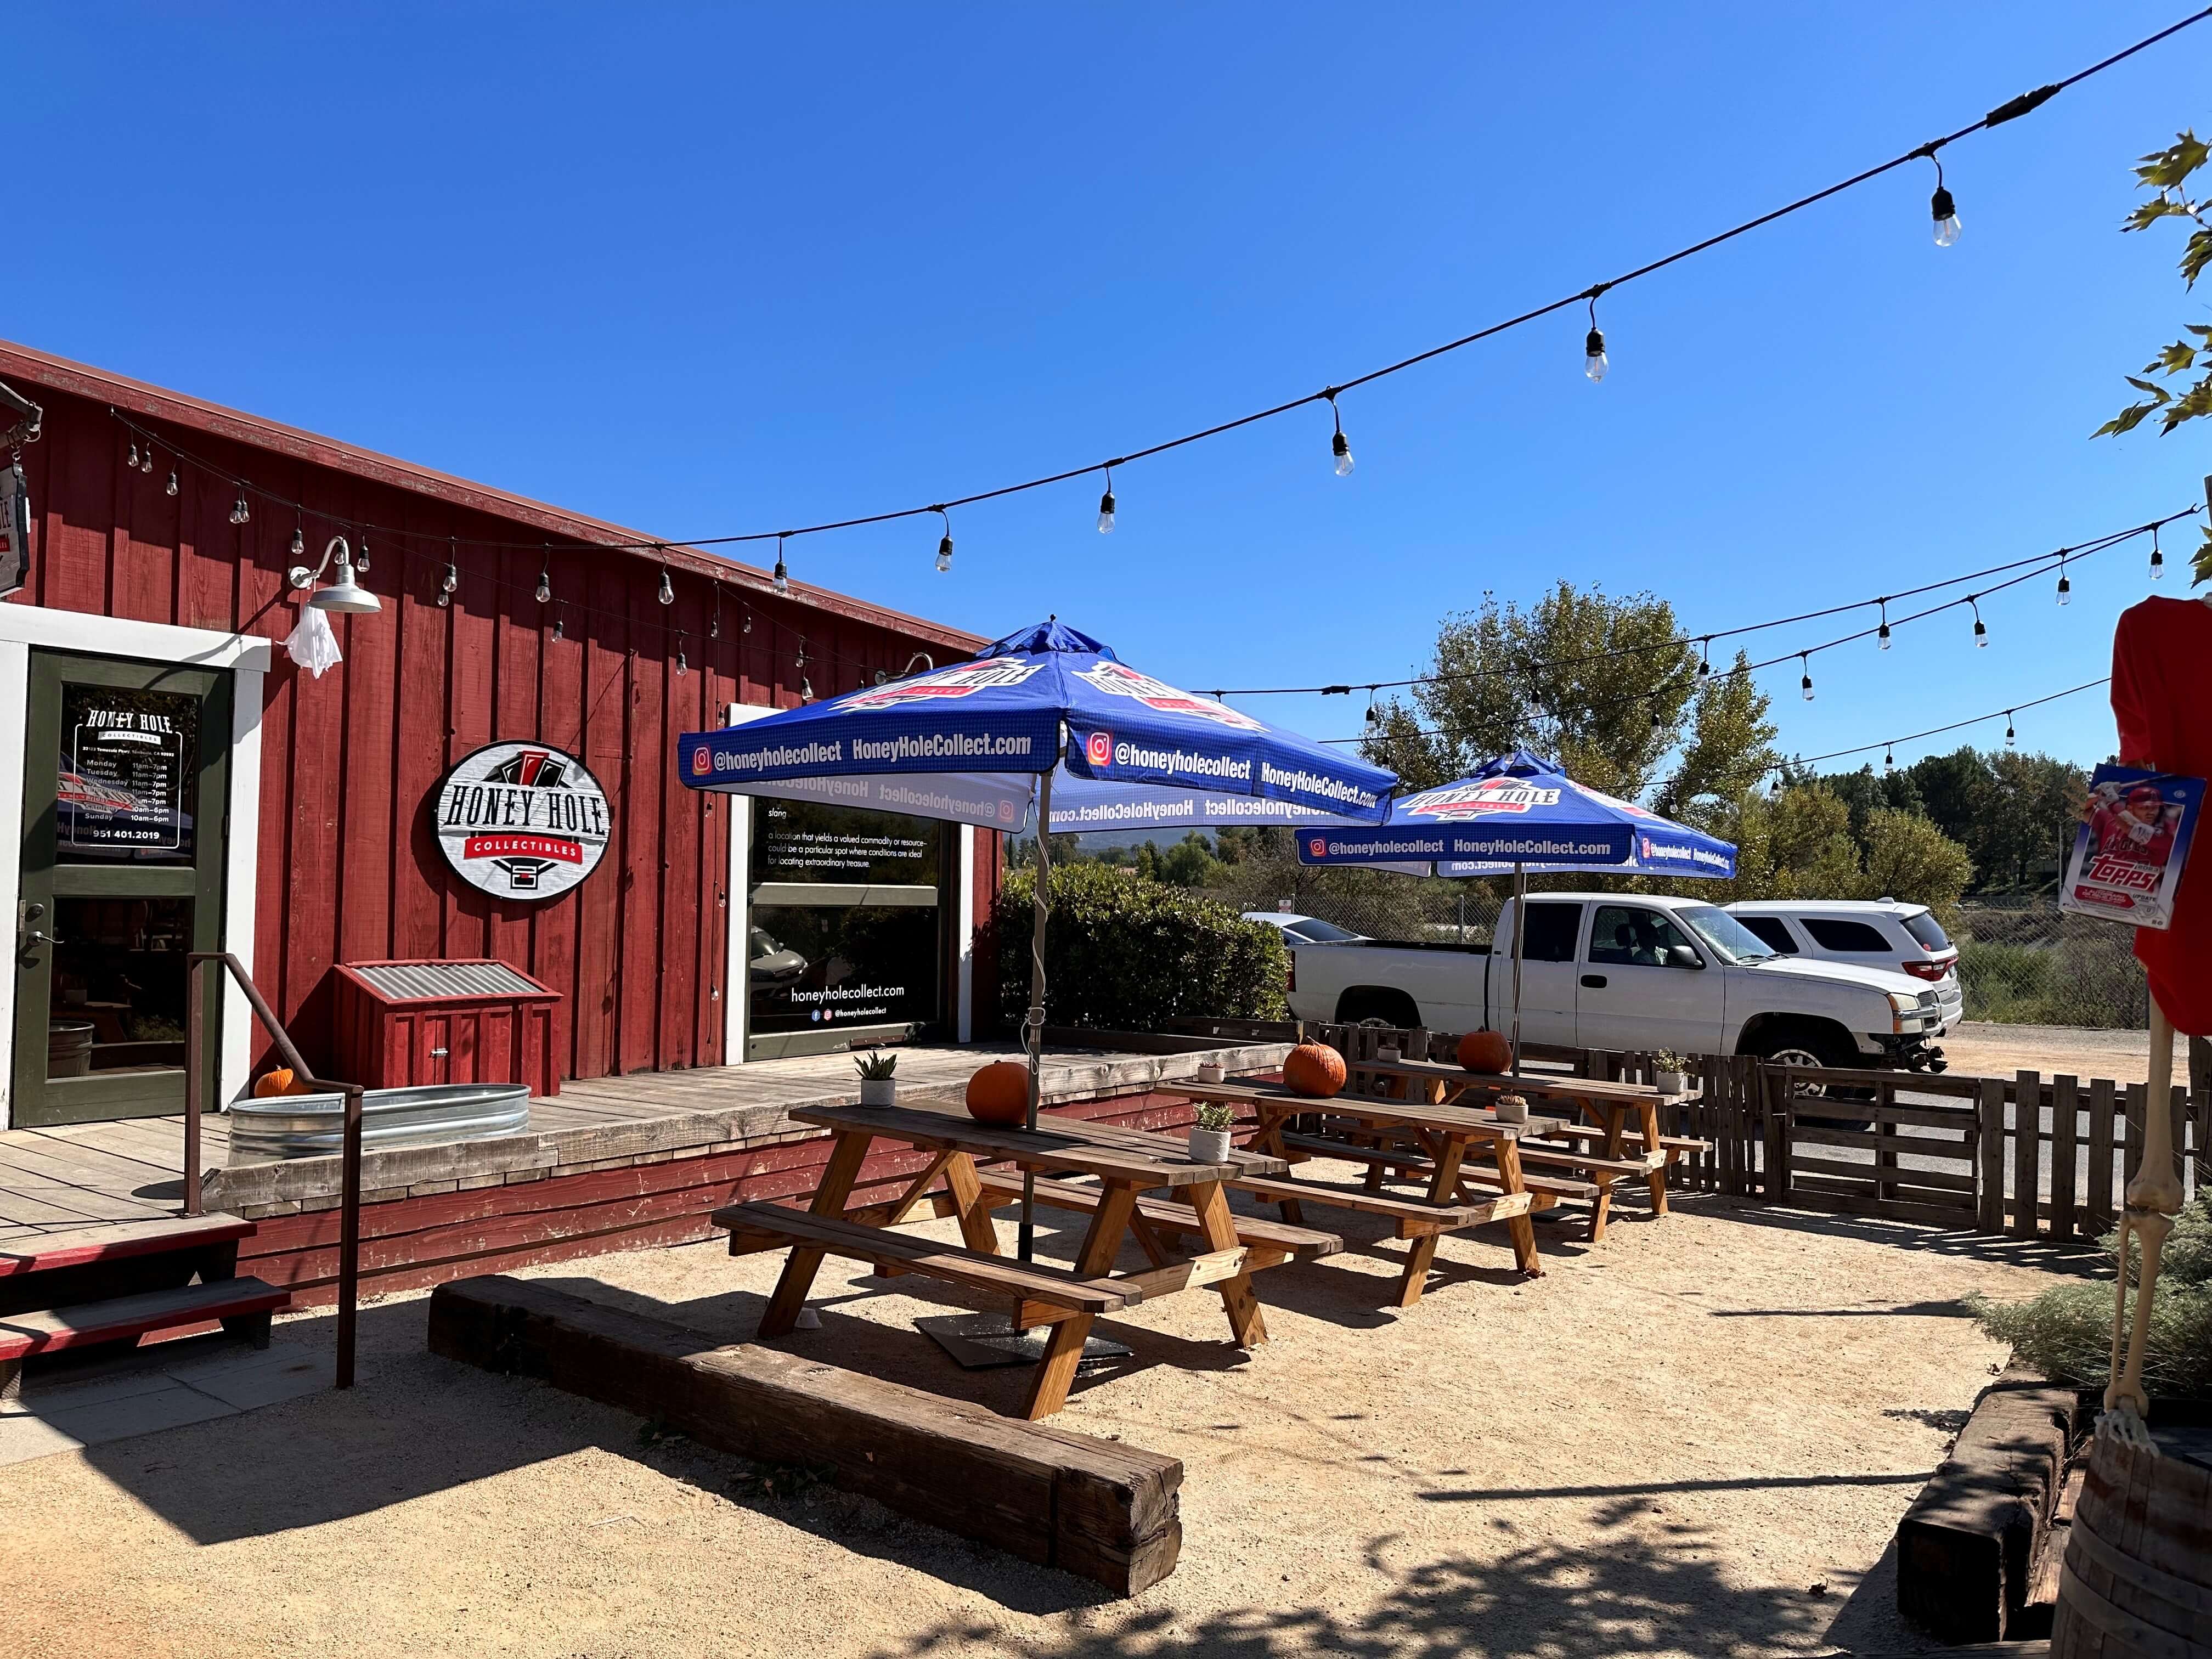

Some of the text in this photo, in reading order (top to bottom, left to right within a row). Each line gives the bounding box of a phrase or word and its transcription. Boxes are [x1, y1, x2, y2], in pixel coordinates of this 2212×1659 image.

[955, 667, 1035, 685] HOLE
[86, 710, 173, 734] HONEY HOLE
[714, 733, 1031, 772] @honeyholecollect HoneyHoleCollect.com
[87, 759, 117, 768] Monday
[87, 768, 117, 777] Tuesday
[1115, 742, 1378, 809] @honeyholecollect HoneyHoleCollect.com
[86, 777, 128, 787] Wednesday
[1407, 790, 1556, 806] HONEY HOLE
[444, 785, 606, 836] HONEY HOLE
[768, 807, 787, 819] slang
[775, 830, 800, 840] location
[802, 831, 814, 841] that
[815, 832, 832, 843] yields
[839, 833, 860, 843] valued
[861, 836, 893, 847] commodity
[473, 840, 577, 857] COLLECTIBLES
[768, 842, 787, 853] could
[788, 843, 797, 853] be
[805, 844, 833, 856] particular
[834, 847, 848, 857] spot
[849, 845, 867, 856] where
[868, 847, 897, 857] conditions
[908, 849, 922, 858] ideal
[1329, 839, 1611, 856] @honeyholecollect HoneyHoleCollect.com
[1650, 843, 1691, 860] @honeyholecollect
[768, 854, 777, 865] for
[778, 855, 804, 868] locating
[805, 857, 845, 869] extraordinary
[2132, 893, 2157, 902] UPDATE
[792, 983, 904, 1005] honeyholecollect.com
[835, 1007, 887, 1018] @honeyholecollect
